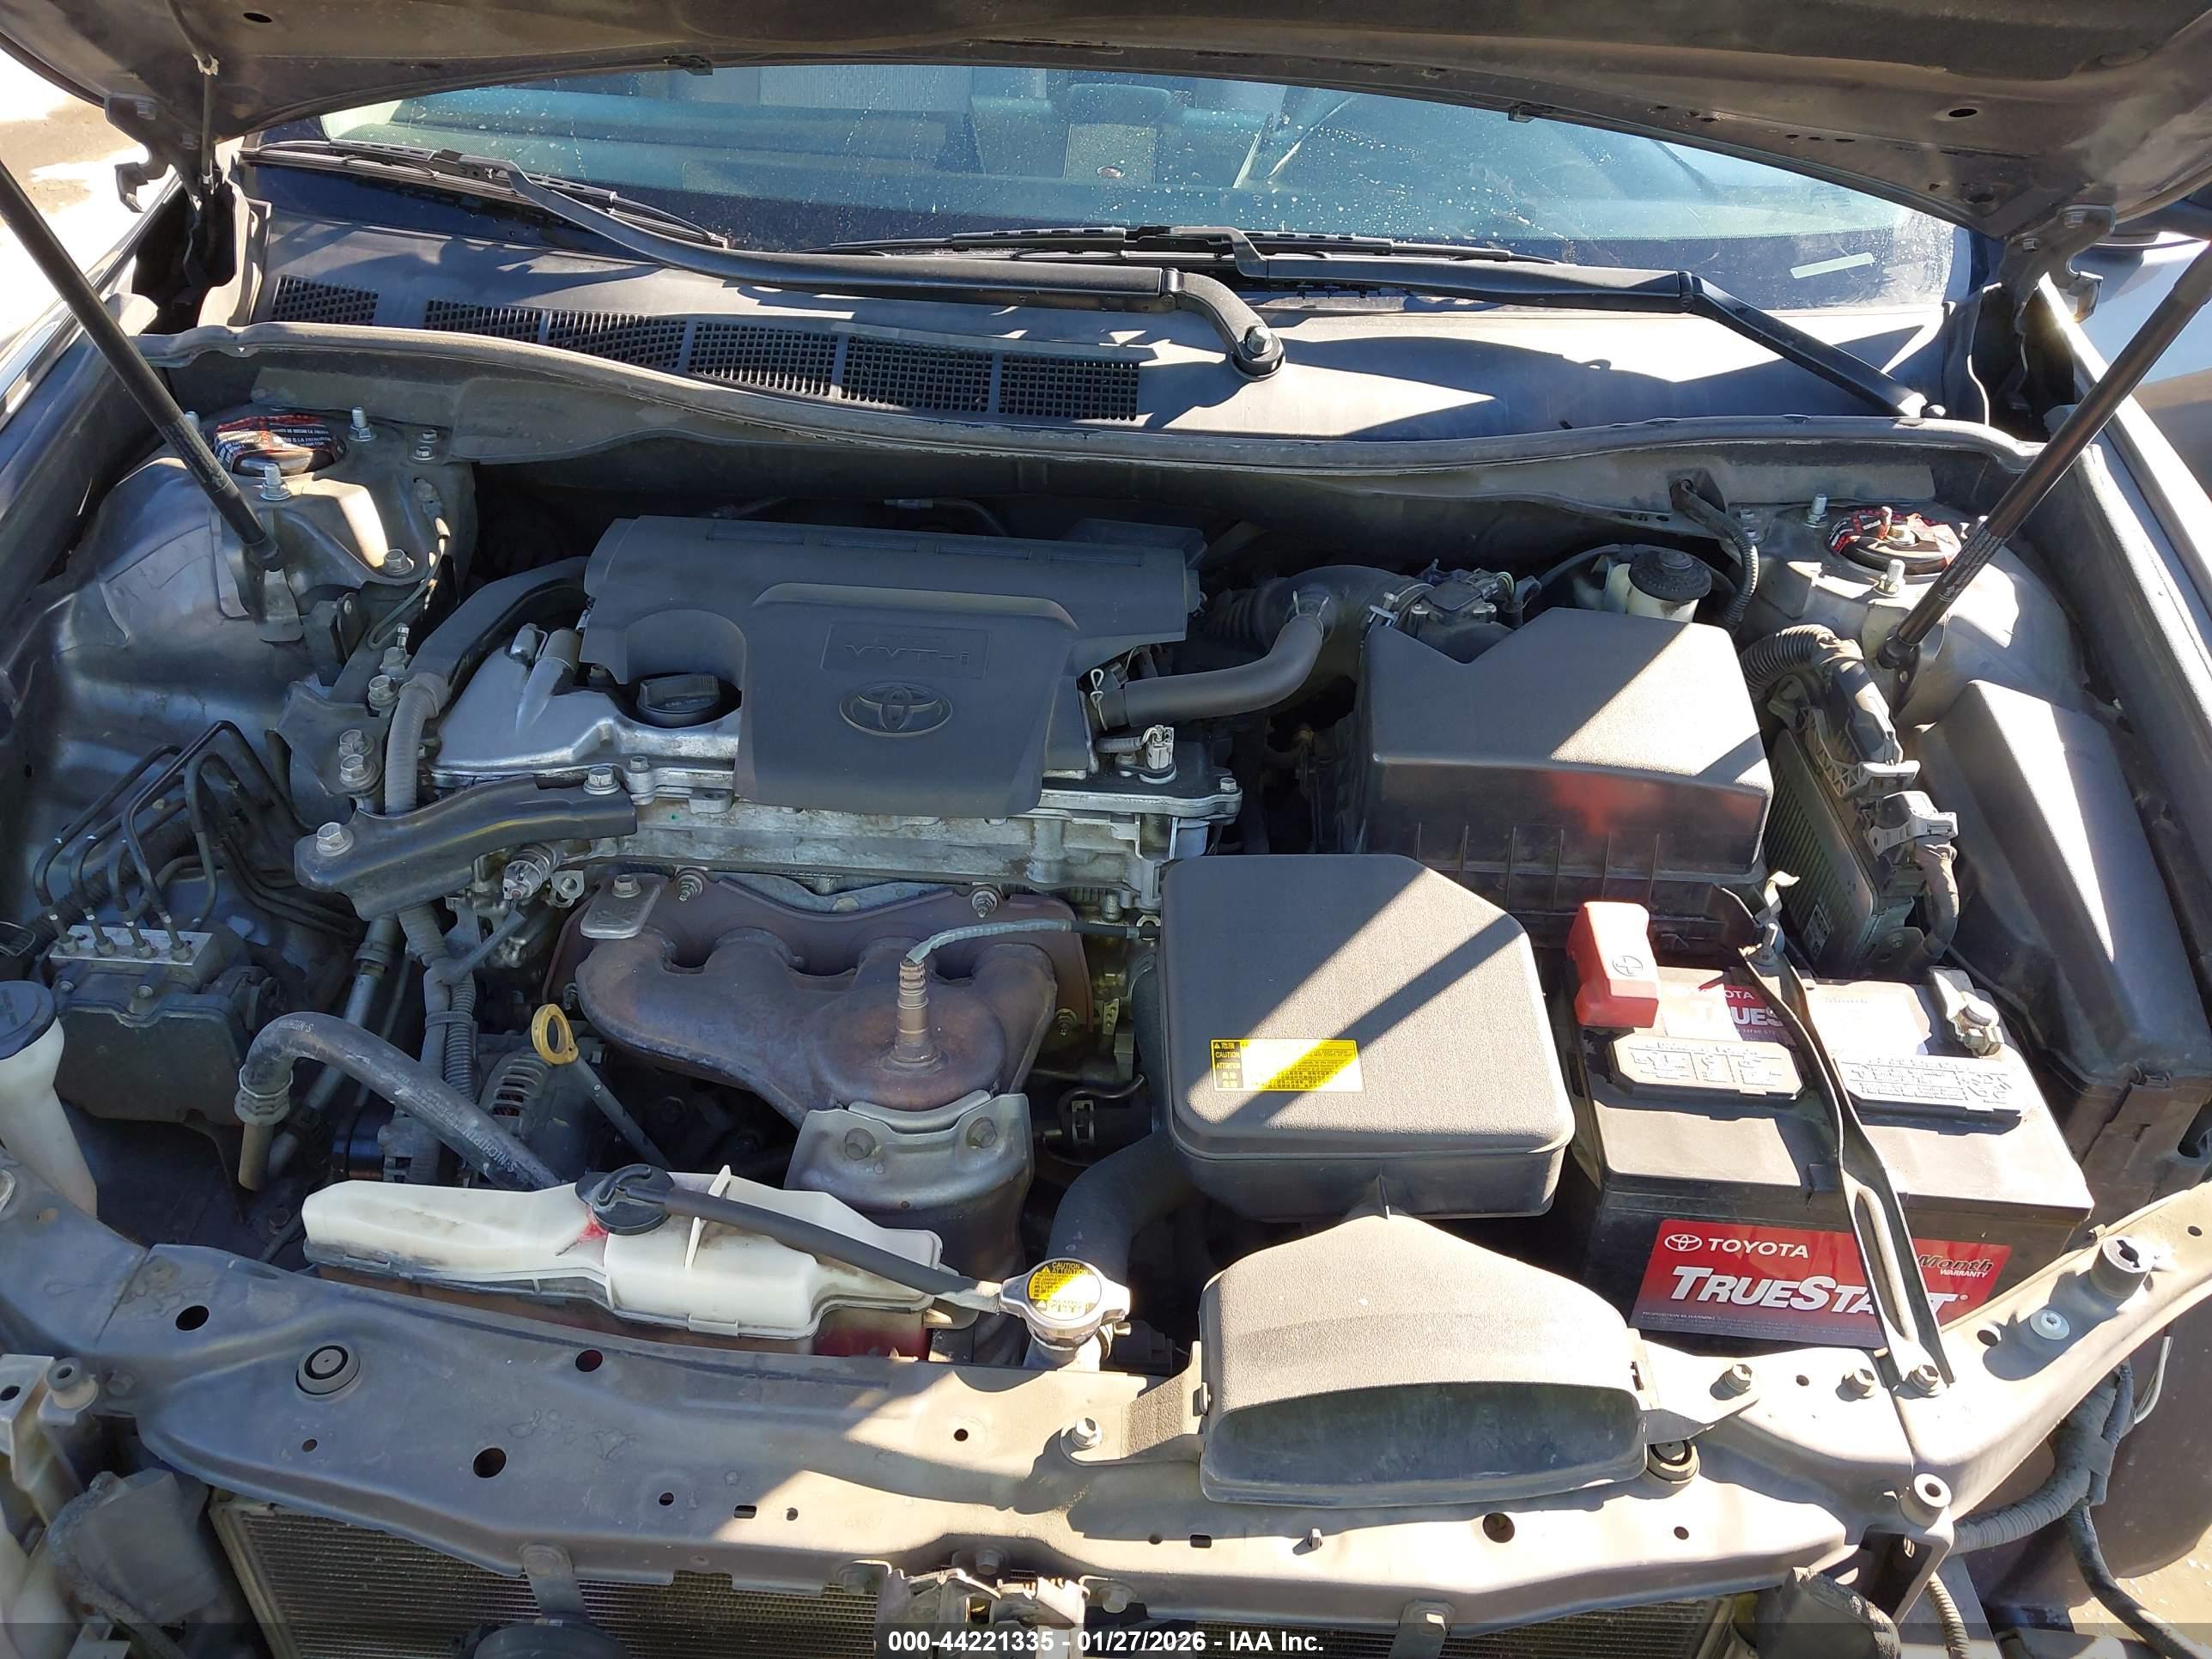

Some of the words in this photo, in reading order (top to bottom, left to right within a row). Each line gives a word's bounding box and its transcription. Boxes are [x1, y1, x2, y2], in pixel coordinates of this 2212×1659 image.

[844, 644, 969, 666] VVT-i
[1709, 1237, 1808, 1258] TOYOTA
[1052, 1261, 1080, 1270] CAUTION
[1918, 1255, 1994, 1272] Month
[1940, 1269, 1988, 1279] WARRANTY
[1671, 1266, 1959, 1316] TRUESTAT
